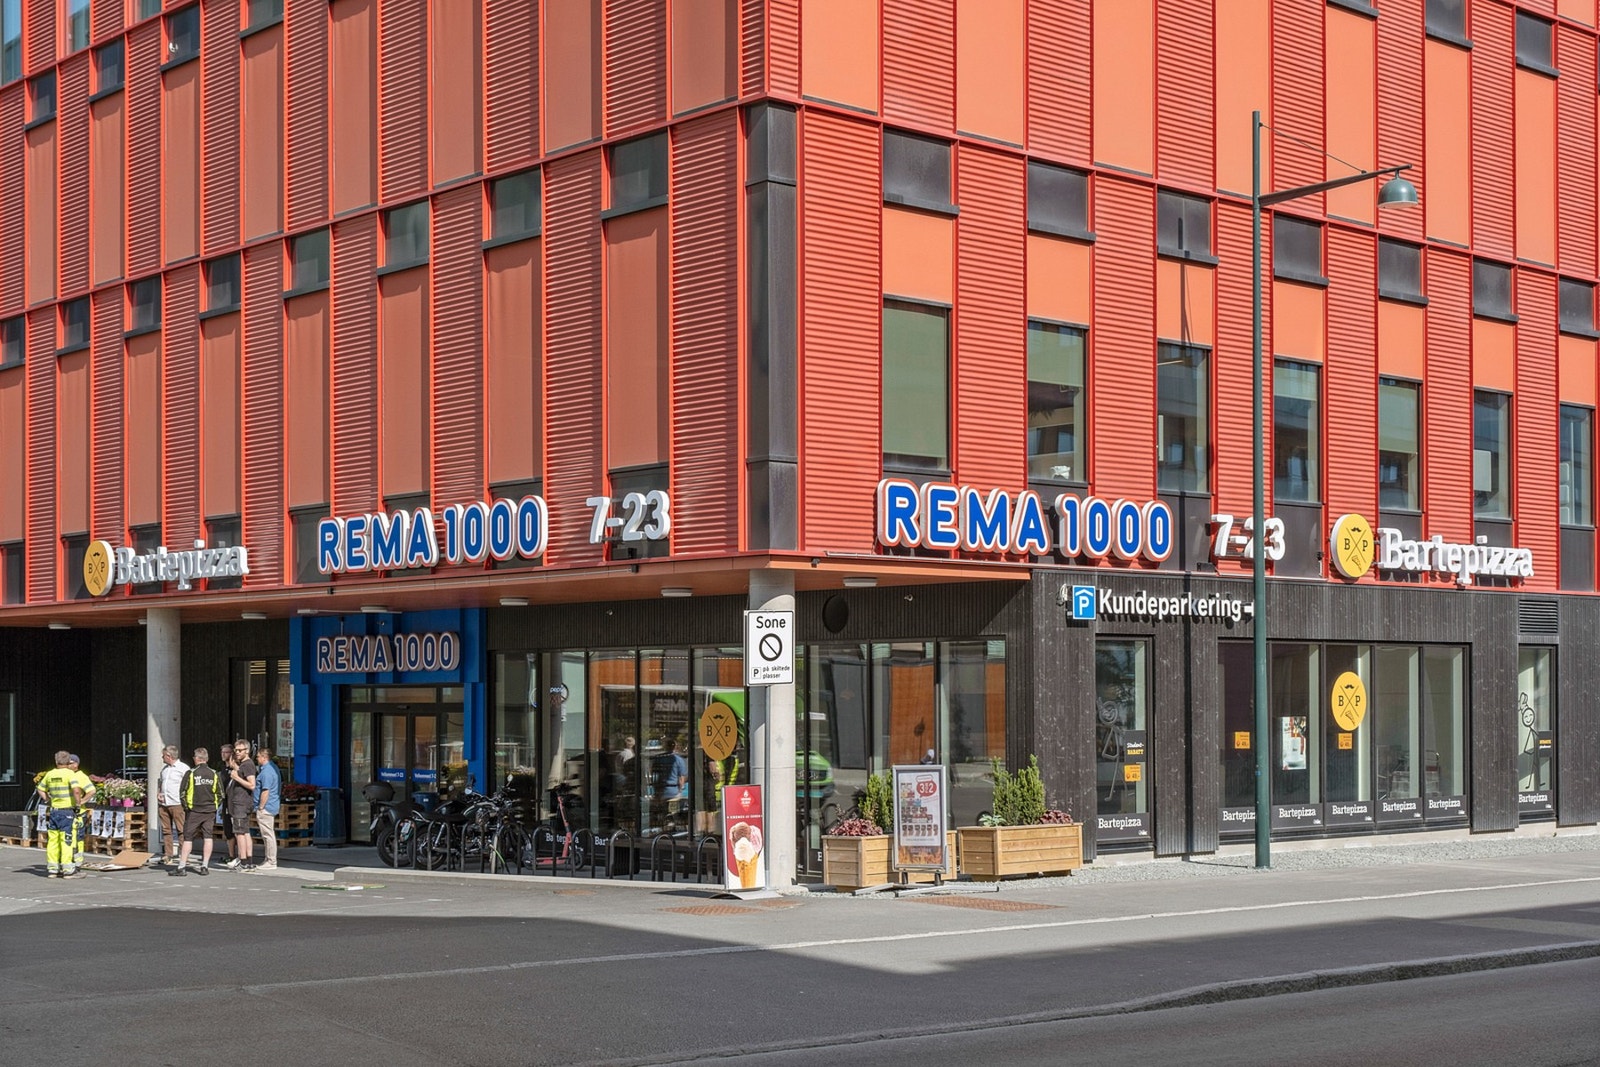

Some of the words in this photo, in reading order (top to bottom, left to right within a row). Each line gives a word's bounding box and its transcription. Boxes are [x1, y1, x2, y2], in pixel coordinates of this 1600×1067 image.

[586, 490, 671, 544] 7-23
[877, 478, 1051, 556] REMA
[1055, 492, 1174, 562] 1000
[317, 506, 440, 574] REMA
[442, 495, 549, 565] 1000
[1343, 537, 1351, 551] B
[1361, 539, 1369, 552] P
[1377, 528, 1534, 585] Bartepizza
[87, 561, 94, 575] B
[99, 561, 106, 574] P
[115, 540, 250, 591] Bartepizza
[1079, 596, 1089, 616] P
[1099, 588, 1242, 622] Kundeparkering
[756, 615, 787, 629] Sone
[316, 633, 394, 674] REMA
[394, 631, 461, 672] 1000
[753, 668, 760, 678] P
[1338, 695, 1345, 707] B
[1355, 695, 1361, 707] P
[706, 725, 713, 737] B
[724, 725, 731, 737] P
[919, 783, 925, 794] 3
[928, 782, 934, 793] 2
[1382, 800, 1417, 812] Bartepizza
[1428, 798, 1461, 811] Bartepizza
[1518, 793, 1548, 805] Bartepizza
[1278, 807, 1317, 820] Bartepizza
[1332, 804, 1368, 816] Bartepizza
[1098, 817, 1142, 830] Bartepizza
